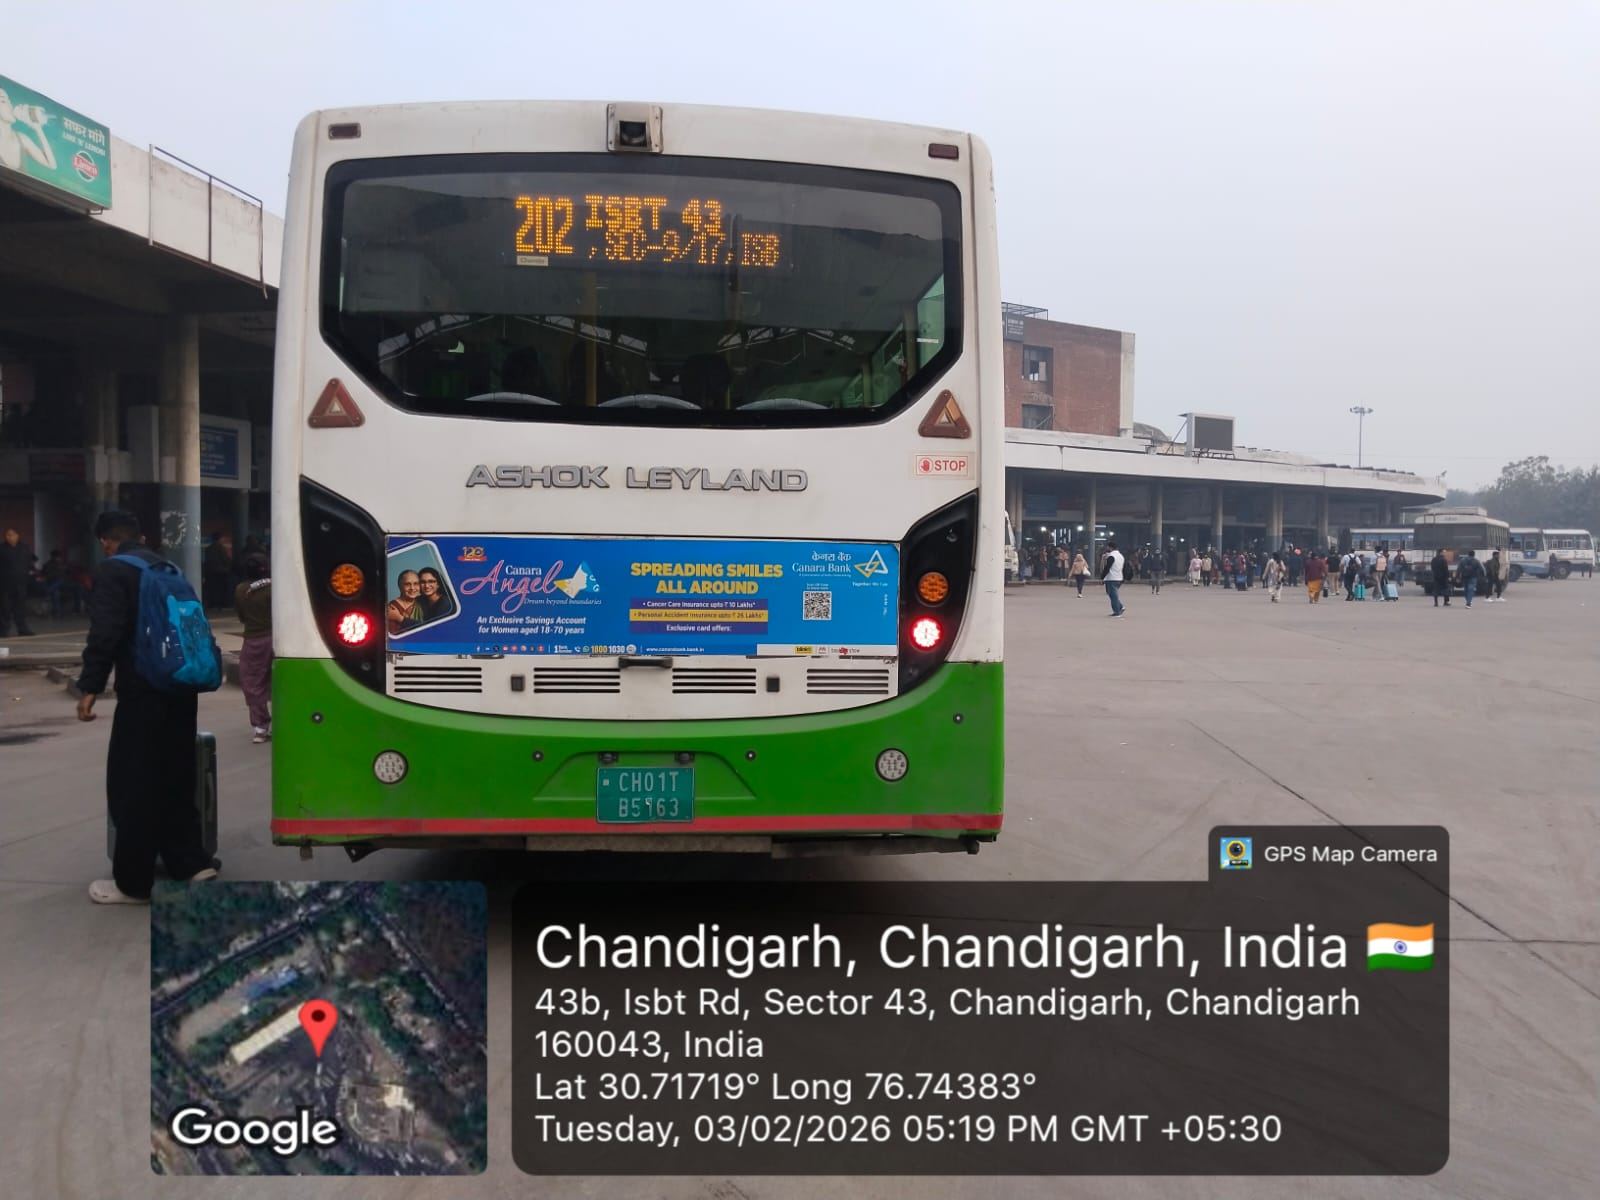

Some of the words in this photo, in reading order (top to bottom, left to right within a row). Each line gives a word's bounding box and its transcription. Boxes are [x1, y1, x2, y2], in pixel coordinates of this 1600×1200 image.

[585, 194, 667, 231] ISBT
[682, 199, 722, 233] 43
[515, 196, 574, 254] 202
[934, 460, 966, 471] STOP
[465, 464, 610, 488] ASHOK
[626, 466, 809, 491] LEYLAND
[505, 565, 542, 576] Canara
[630, 562, 723, 577] SPREADING
[726, 564, 783, 577] SMILES
[792, 562, 825, 573] Canara
[828, 563, 851, 573] Bank
[460, 559, 564, 614] Angel
[656, 580, 686, 594] ALL
[689, 580, 759, 594] AROUND
[710, 601, 724, 609] upto
[477, 616, 488, 624] An
[488, 616, 524, 624] Exclusive
[525, 616, 555, 626] Savings
[555, 616, 586, 624] Account
[520, 626, 539, 635] aged
[540, 626, 564, 634] 18-70
[564, 627, 585, 635] years
[666, 624, 695, 632] Exclusive
[696, 624, 711, 632] card
[711, 624, 732, 632] offers:
[591, 645, 608, 654] 1800
[608, 645, 625, 654] 1030
[619, 771, 679, 792] CH01T
